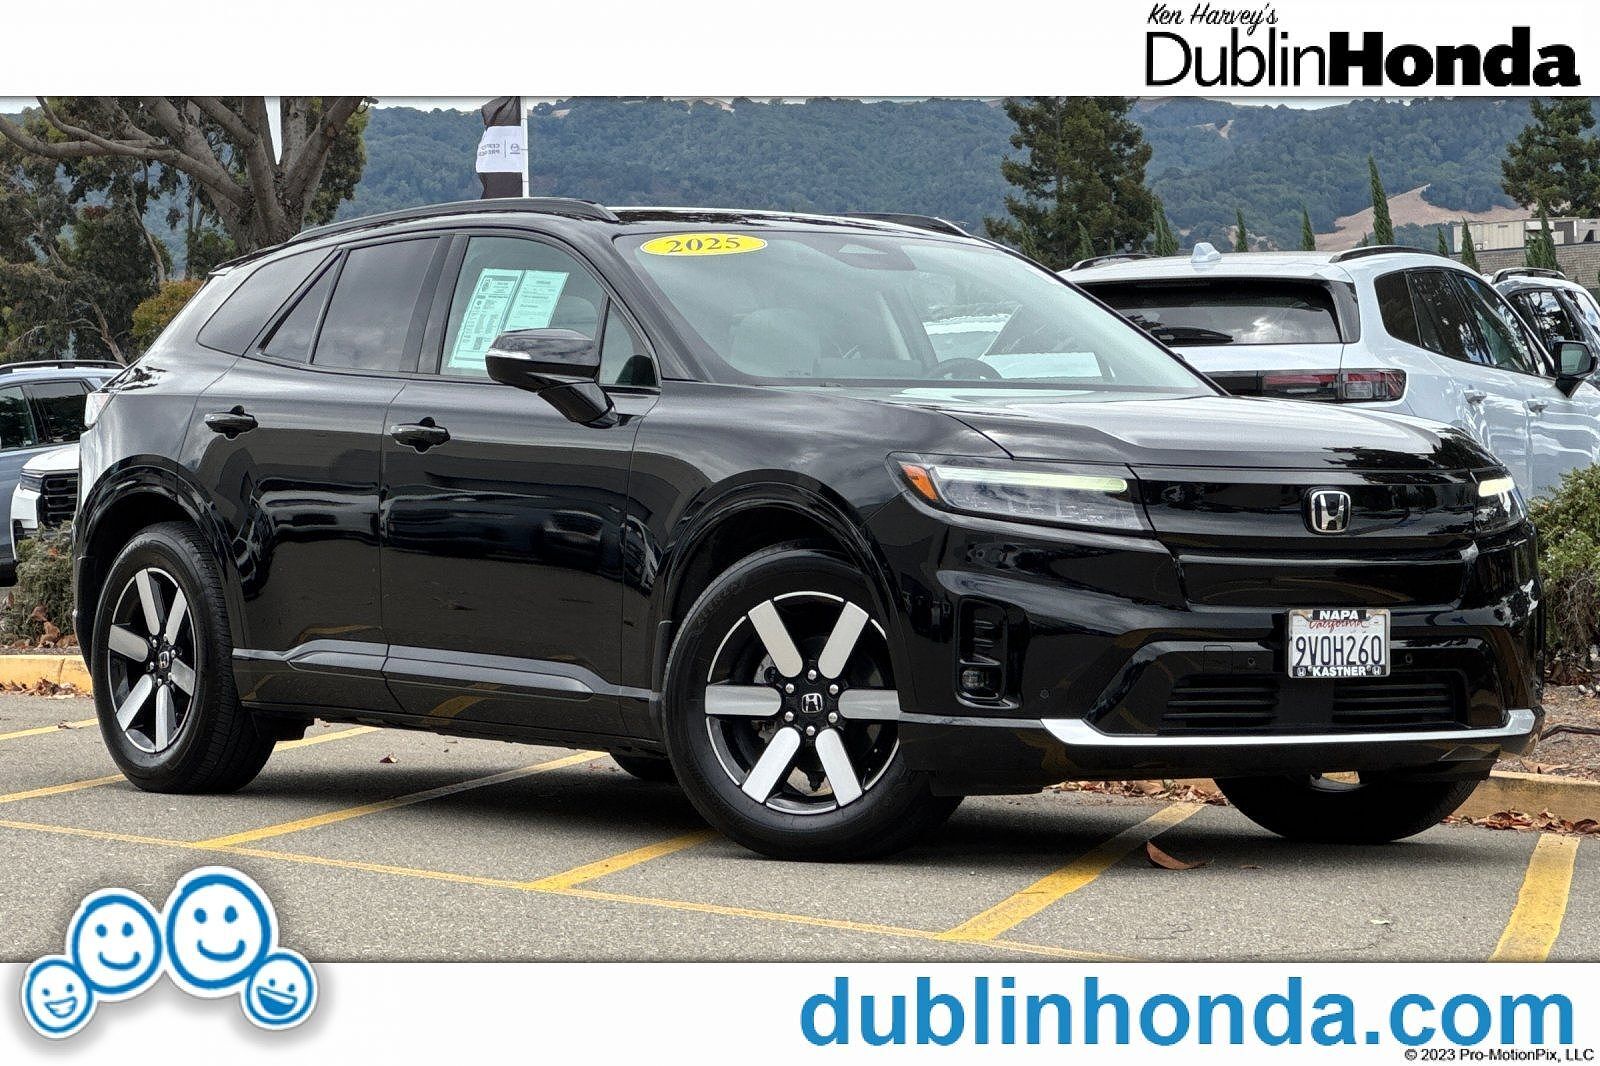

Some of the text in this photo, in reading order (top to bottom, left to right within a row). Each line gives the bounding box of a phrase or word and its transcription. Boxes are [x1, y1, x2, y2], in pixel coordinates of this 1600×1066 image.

[665, 237, 741, 253] 2025
[1319, 610, 1359, 620] NAPA
[1295, 635, 1382, 666] 9VOH260
[1312, 666, 1367, 677] KASTNER
